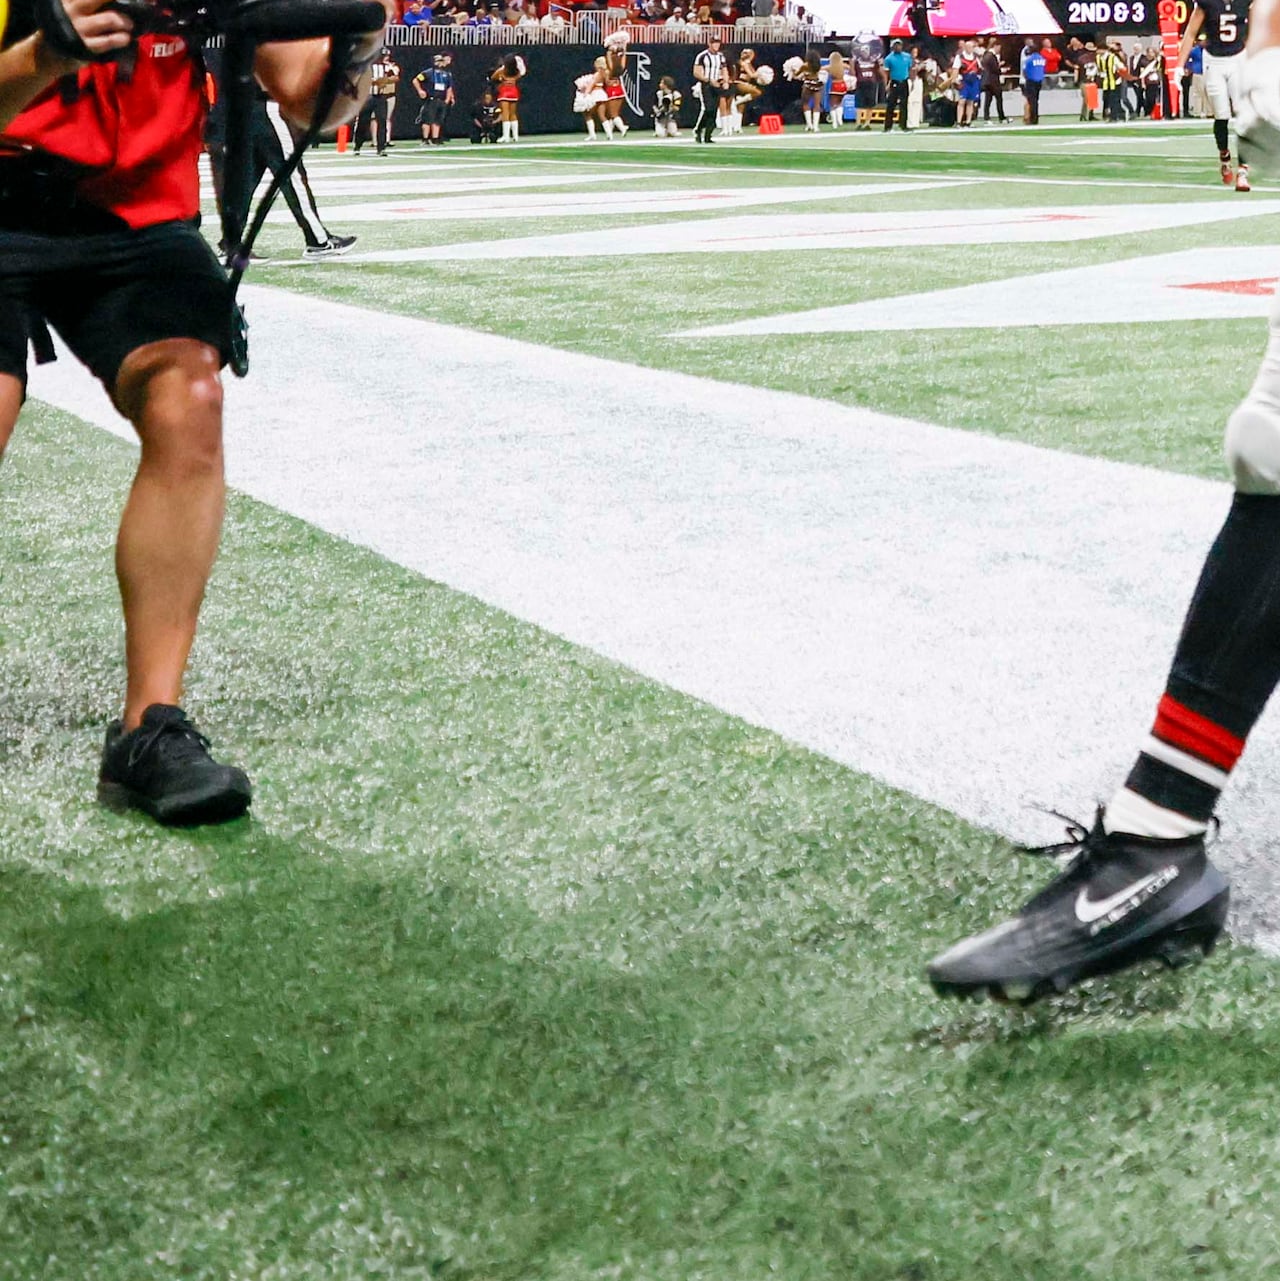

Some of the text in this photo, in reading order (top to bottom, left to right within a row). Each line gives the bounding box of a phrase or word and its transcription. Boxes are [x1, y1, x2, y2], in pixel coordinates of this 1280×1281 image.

[1068, 1, 1146, 23] 2ND & 3
[1219, 13, 1238, 43] 5
[766, 114, 780, 132] 10
